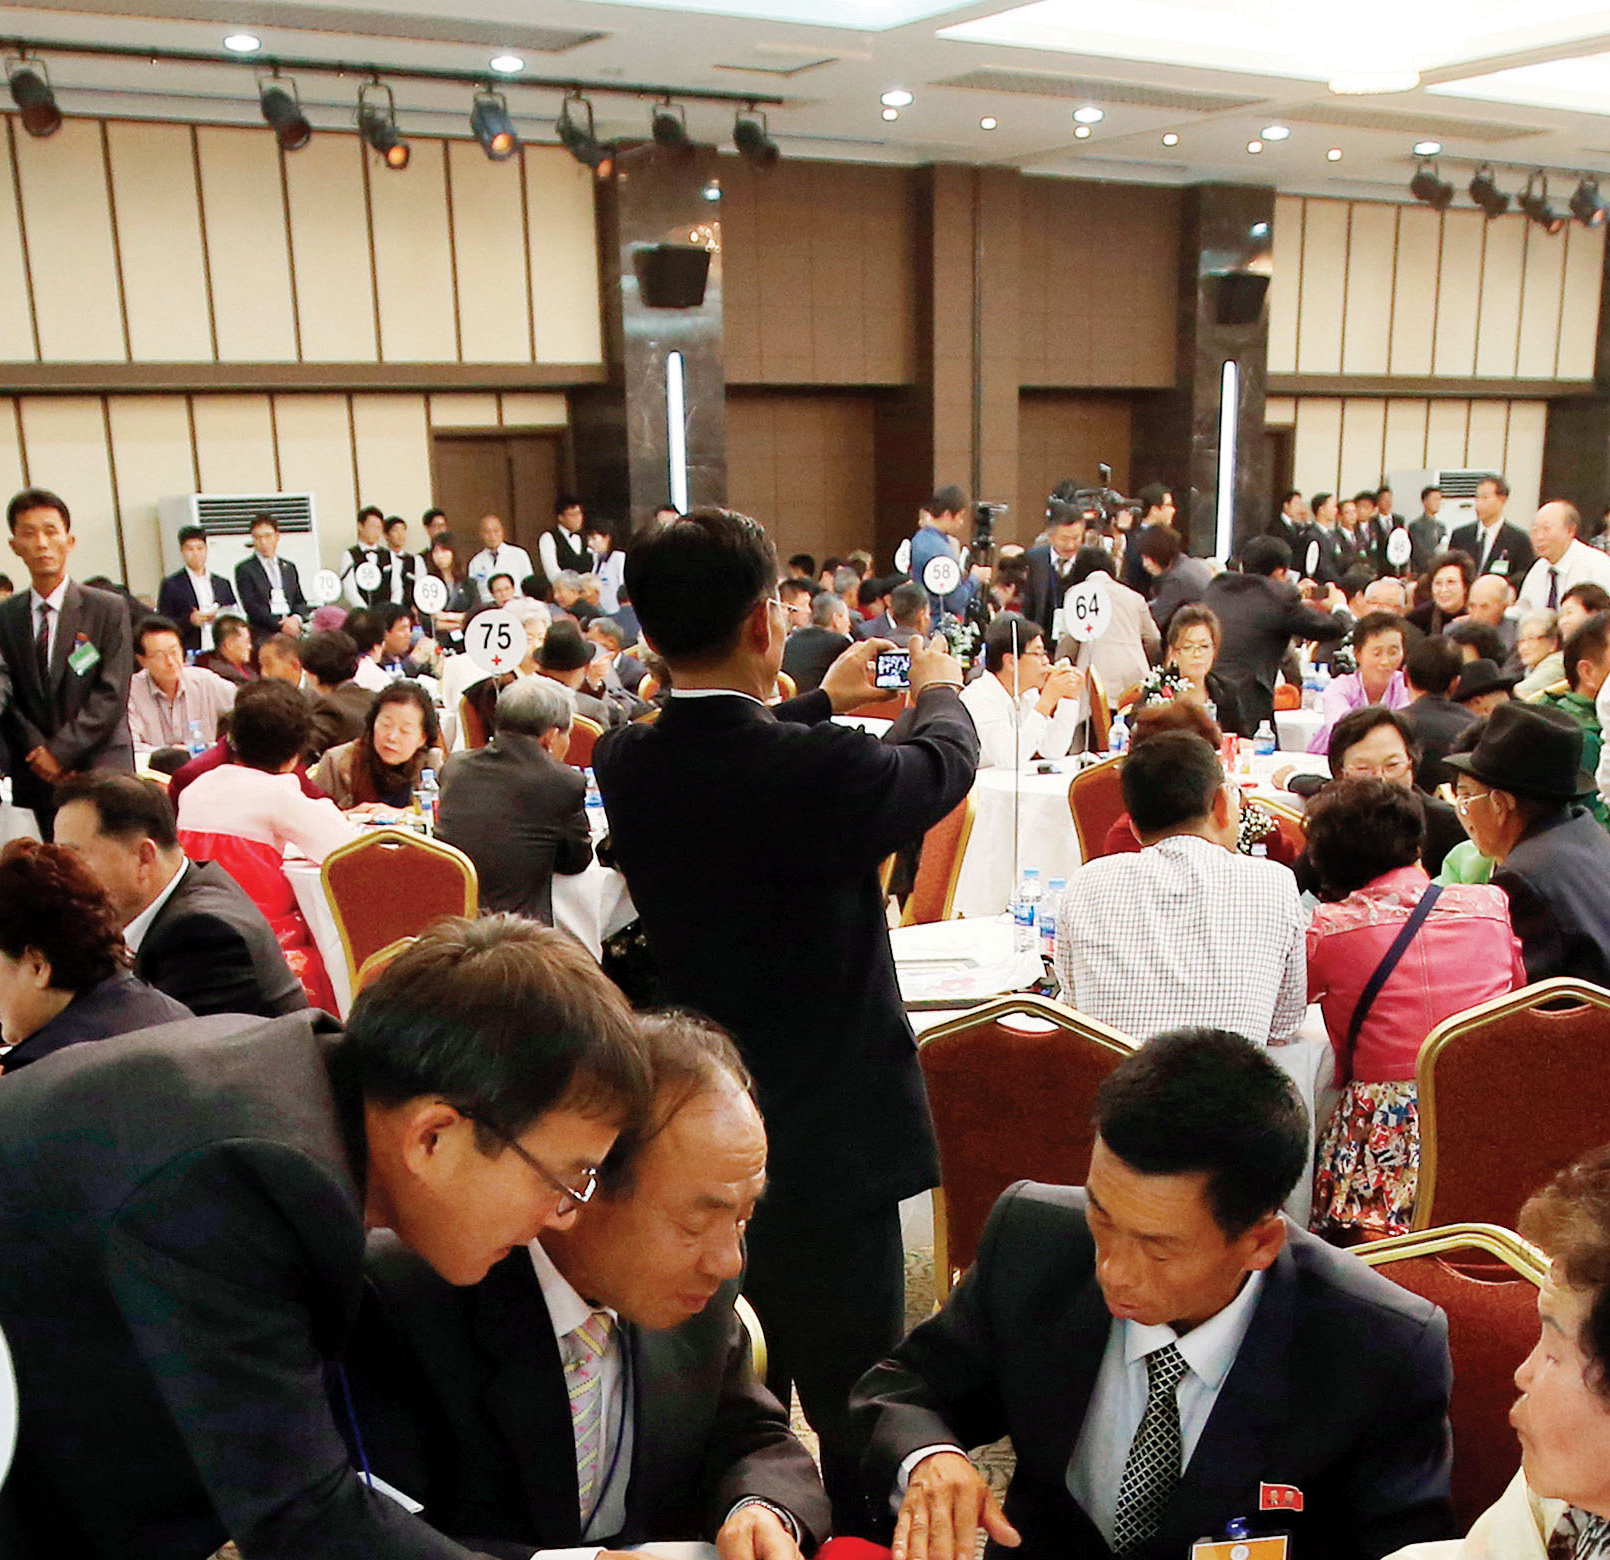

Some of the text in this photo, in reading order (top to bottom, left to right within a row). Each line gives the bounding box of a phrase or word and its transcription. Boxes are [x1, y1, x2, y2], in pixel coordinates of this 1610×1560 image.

[932, 564, 951, 580] 58
[318, 575, 334, 590] 70
[421, 583, 439, 599] 69
[1075, 592, 1100, 620] 64
[479, 623, 512, 650] 75
